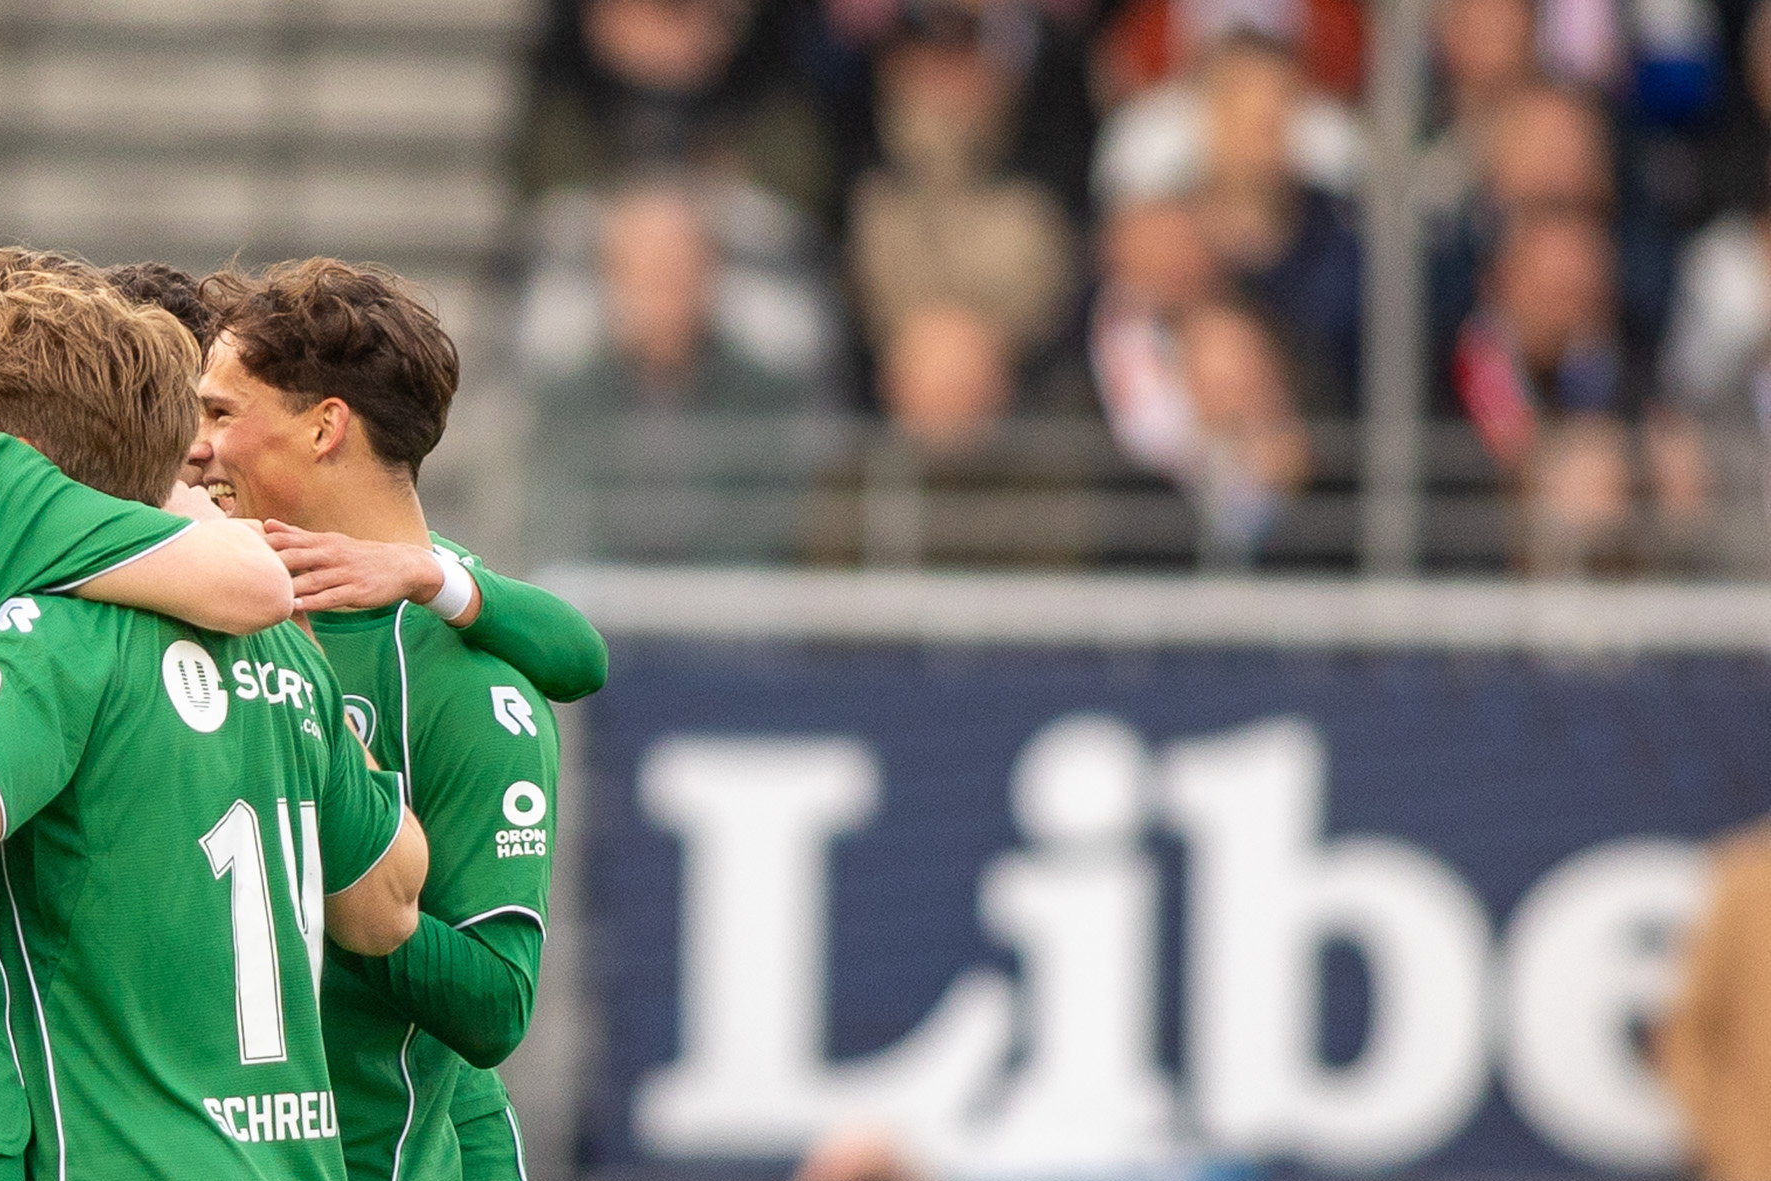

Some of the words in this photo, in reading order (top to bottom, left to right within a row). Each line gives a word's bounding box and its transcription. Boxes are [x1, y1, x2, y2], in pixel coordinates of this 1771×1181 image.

[300, 718, 323, 741] .CO
[495, 828, 547, 844] ORON
[496, 842, 547, 859] HALO
[202, 1090, 338, 1143] SCHREU
